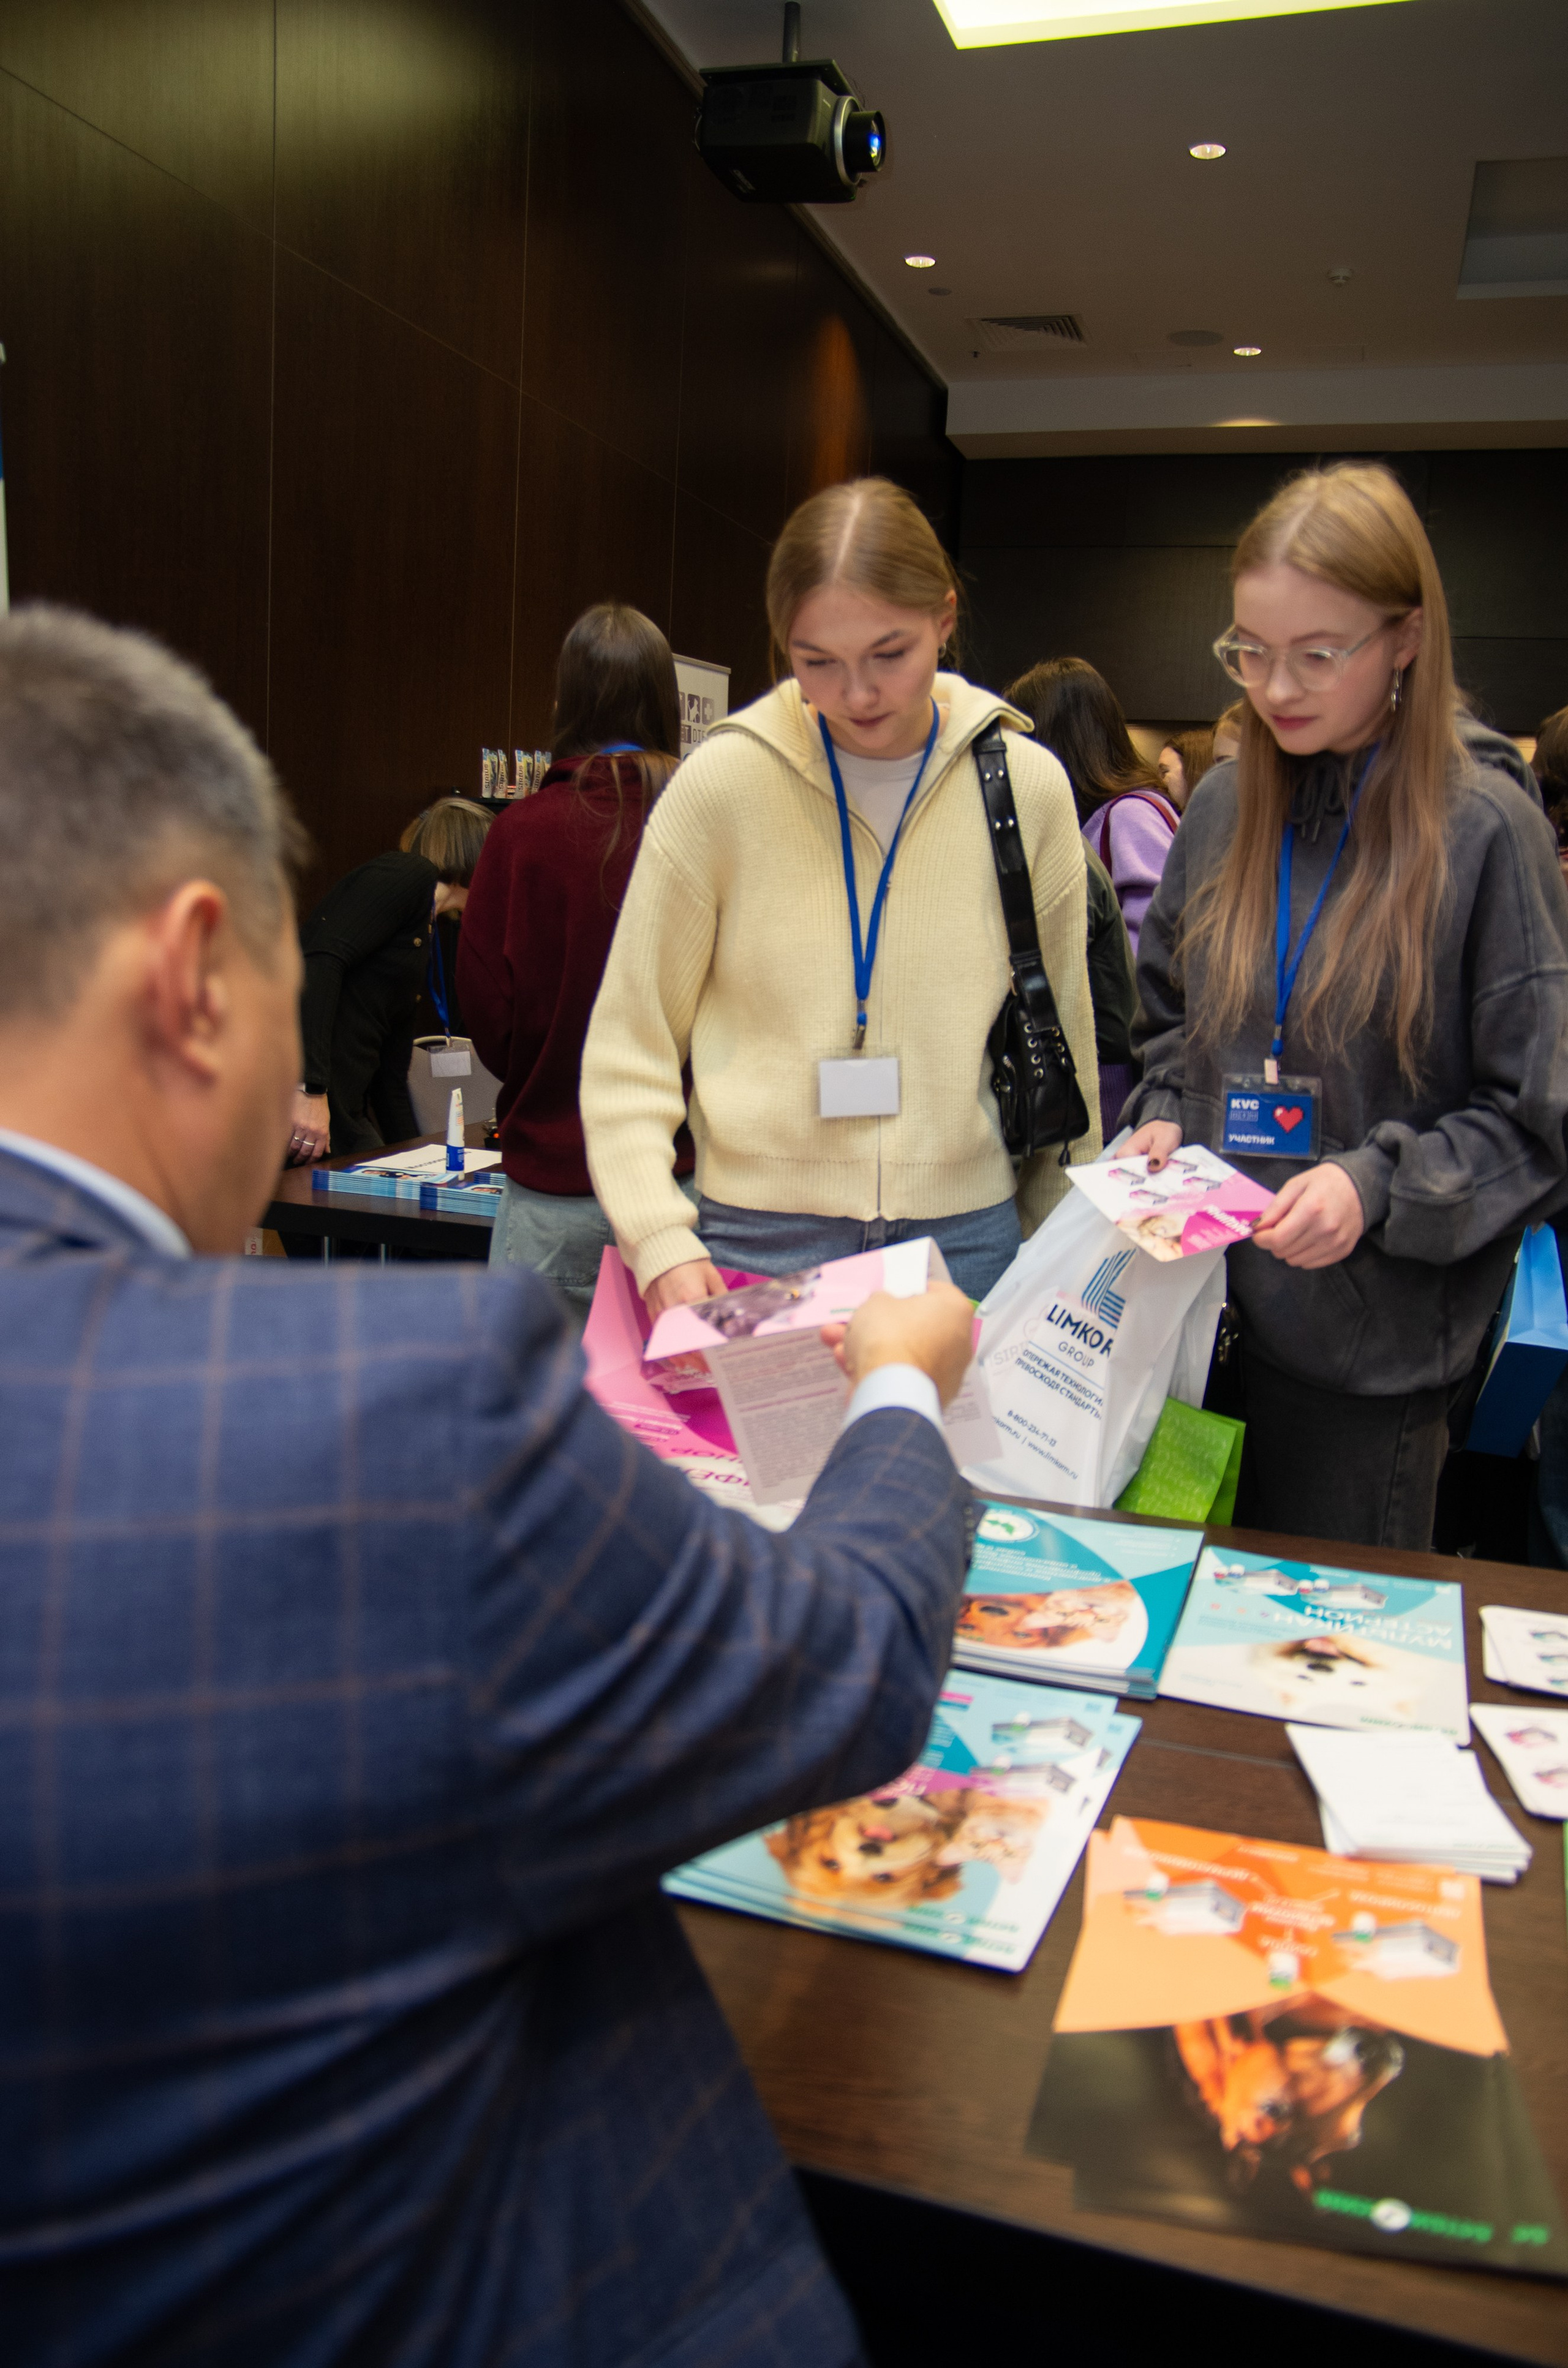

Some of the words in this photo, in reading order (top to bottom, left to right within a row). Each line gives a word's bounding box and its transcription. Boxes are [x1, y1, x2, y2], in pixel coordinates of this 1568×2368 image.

[1231, 1098, 1260, 1110] KVC
[1228, 1133, 1275, 1145] УЧАСТНИК
[1022, 1349, 1061, 1378] ОПЕРЕЖАЯ
[1058, 1341, 1095, 1368] GROUP
[1015, 1357, 1061, 1391] ПРЕВОСХОДЯ
[1027, 1441, 1079, 1480] www.limkorm.ru
